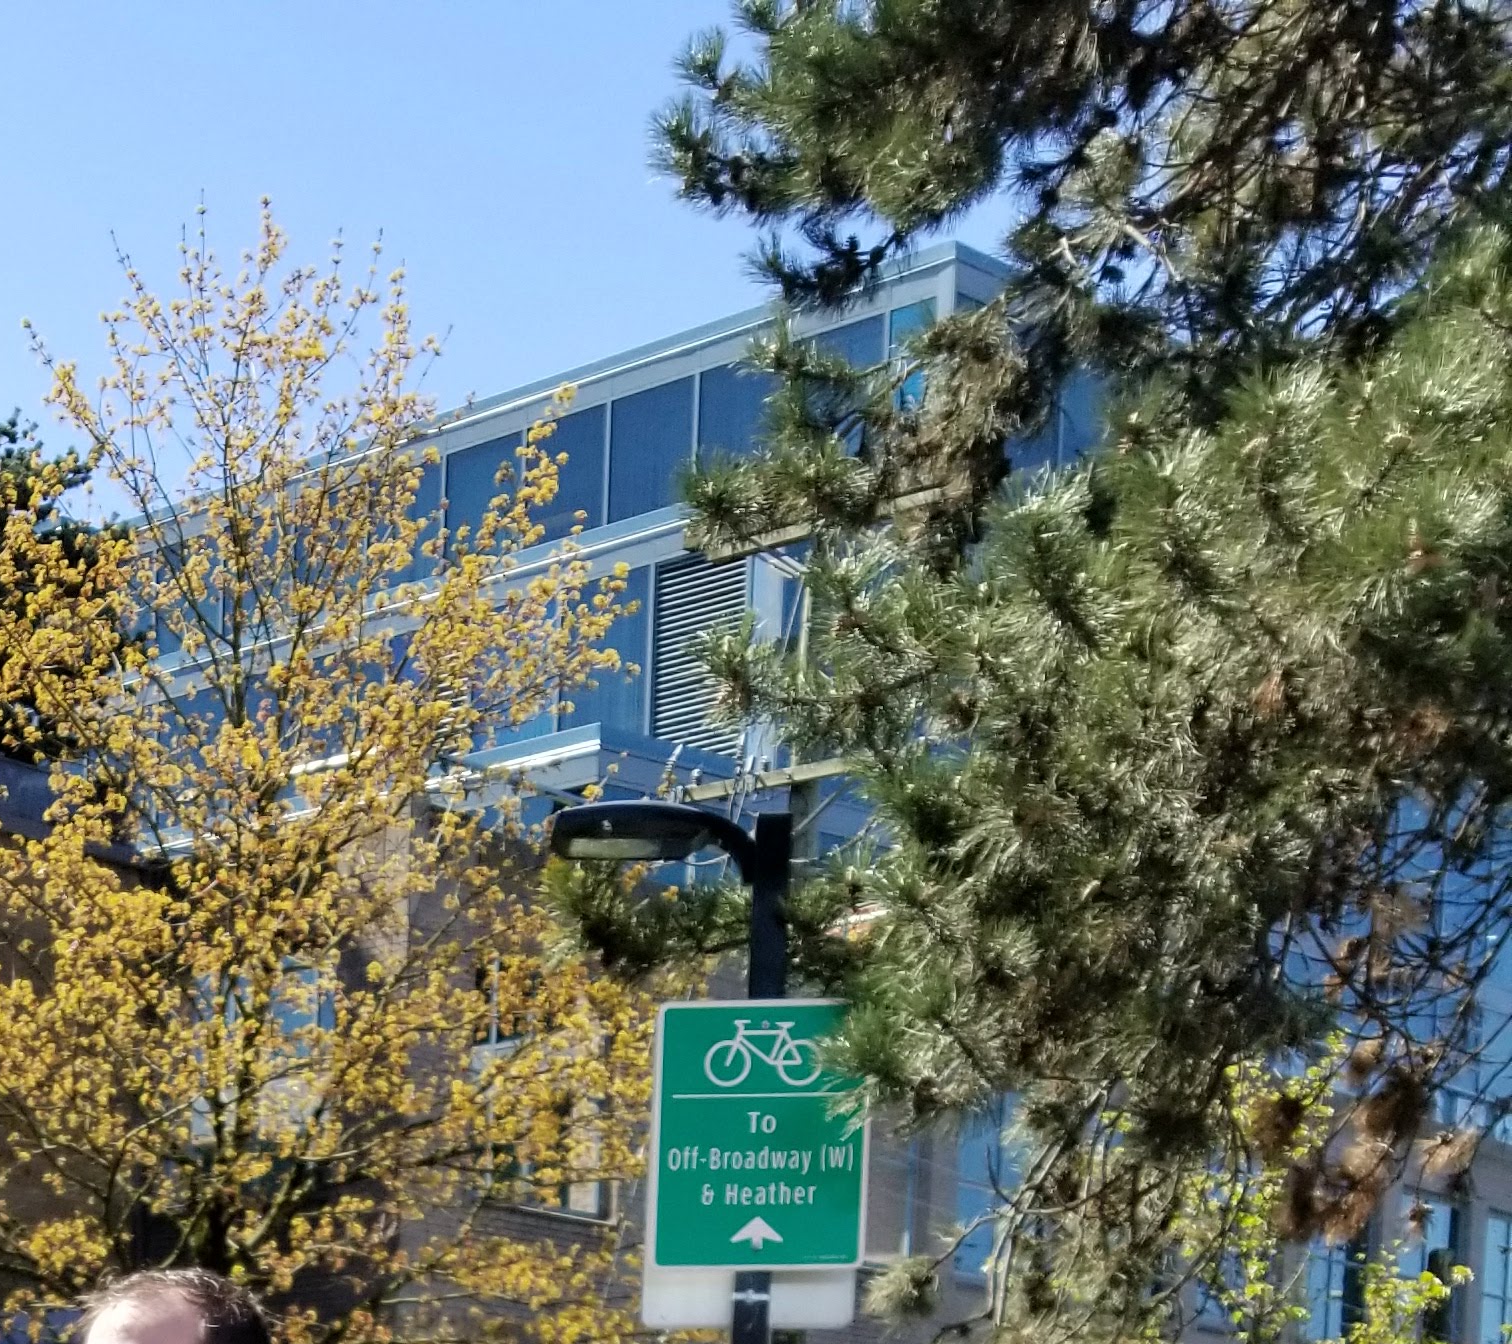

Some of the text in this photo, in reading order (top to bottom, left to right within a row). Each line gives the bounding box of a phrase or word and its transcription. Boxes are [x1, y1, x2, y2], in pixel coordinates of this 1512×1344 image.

[747, 1110, 777, 1134] To
[667, 1142, 854, 1175] Off-Broadway (W)
[701, 1182, 817, 1206] & Heather
